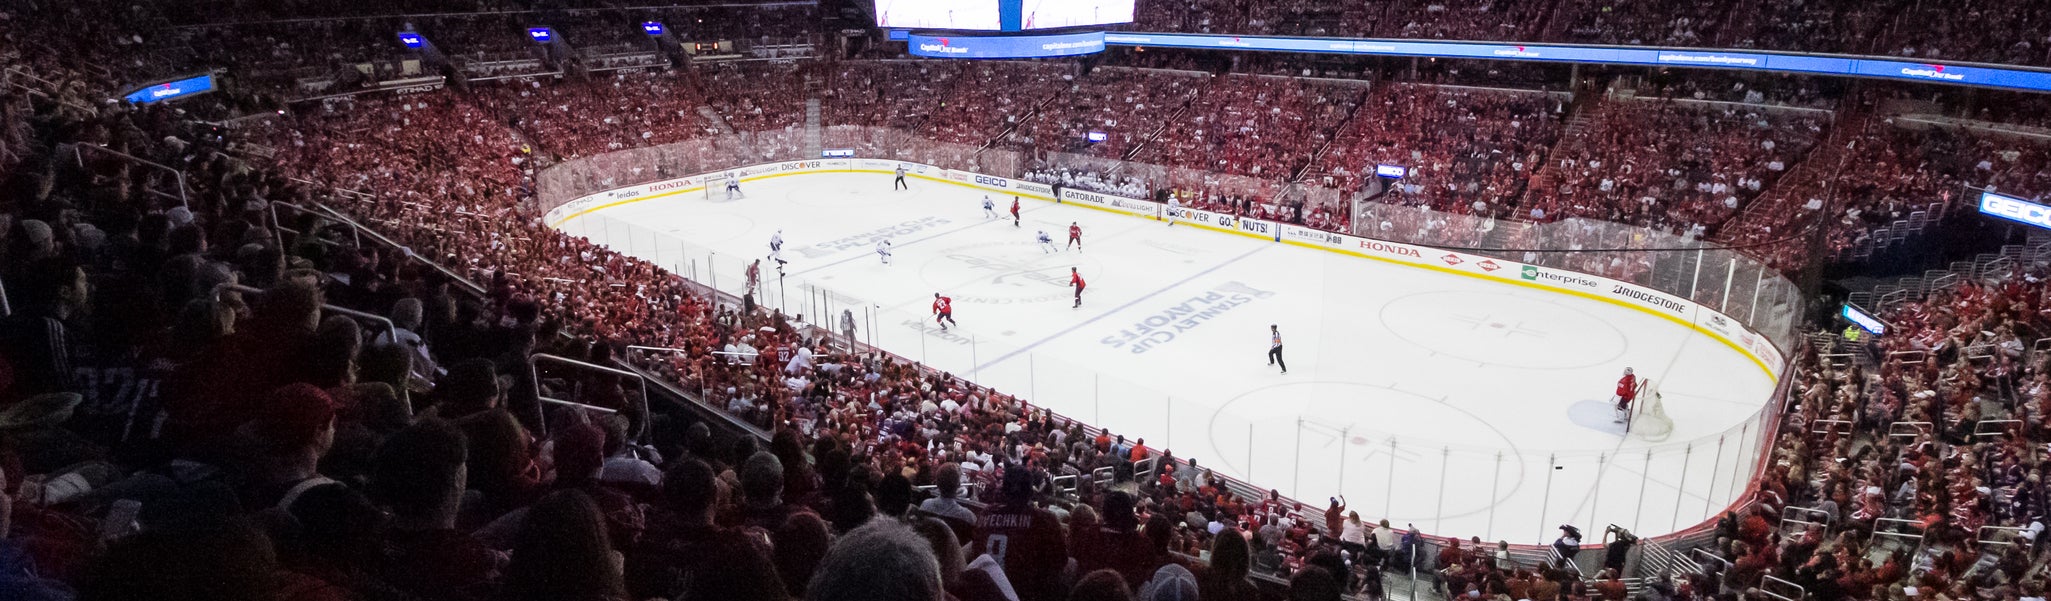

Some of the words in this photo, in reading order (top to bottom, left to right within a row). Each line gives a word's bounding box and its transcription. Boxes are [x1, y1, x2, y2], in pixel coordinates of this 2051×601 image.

[781, 161, 821, 171] DISCOVER
[649, 179, 692, 192] HONDA
[975, 175, 1007, 188] GEICO
[616, 190, 640, 200] leidos
[1065, 190, 1105, 204] GATORADE
[1242, 219, 1268, 234] NUTS!
[1359, 240, 1422, 258] HONDA
[1612, 284, 1686, 314] BRIDGESTONE
[1100, 290, 1225, 349] PLAYOFFS
[1173, 293, 1252, 333] STANLEY
[1131, 330, 1176, 354] CUP
